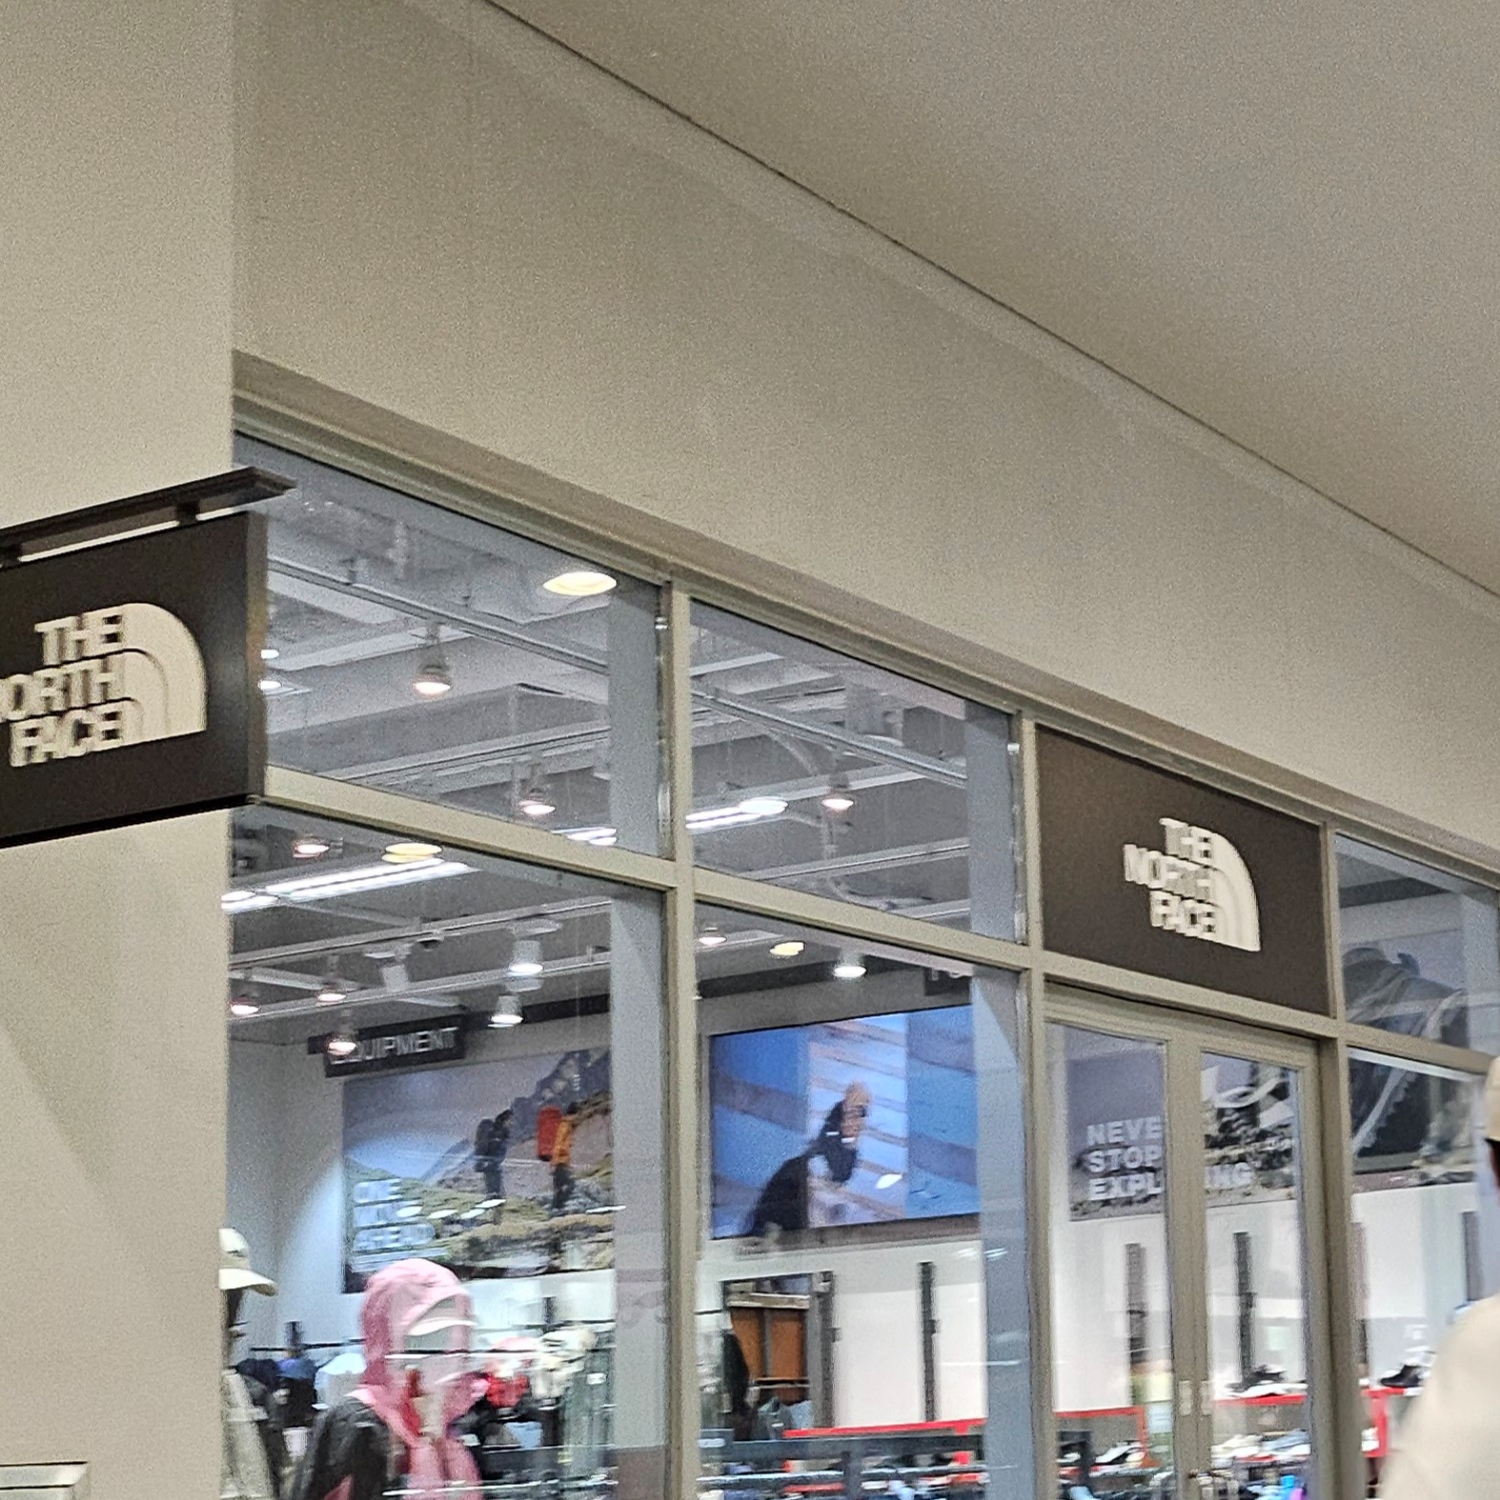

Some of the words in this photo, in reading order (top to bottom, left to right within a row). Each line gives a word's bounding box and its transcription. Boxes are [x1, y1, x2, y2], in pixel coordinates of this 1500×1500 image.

[34, 605, 123, 666] THE
[0, 653, 124, 723] ORTH
[9, 701, 124, 768] FACE
[1159, 818, 1214, 867] THE
[1123, 844, 1213, 904] NORTH
[1150, 890, 1216, 944] FACE
[1087, 1115, 1163, 1146] NEVE
[1088, 1144, 1163, 1173] STOP
